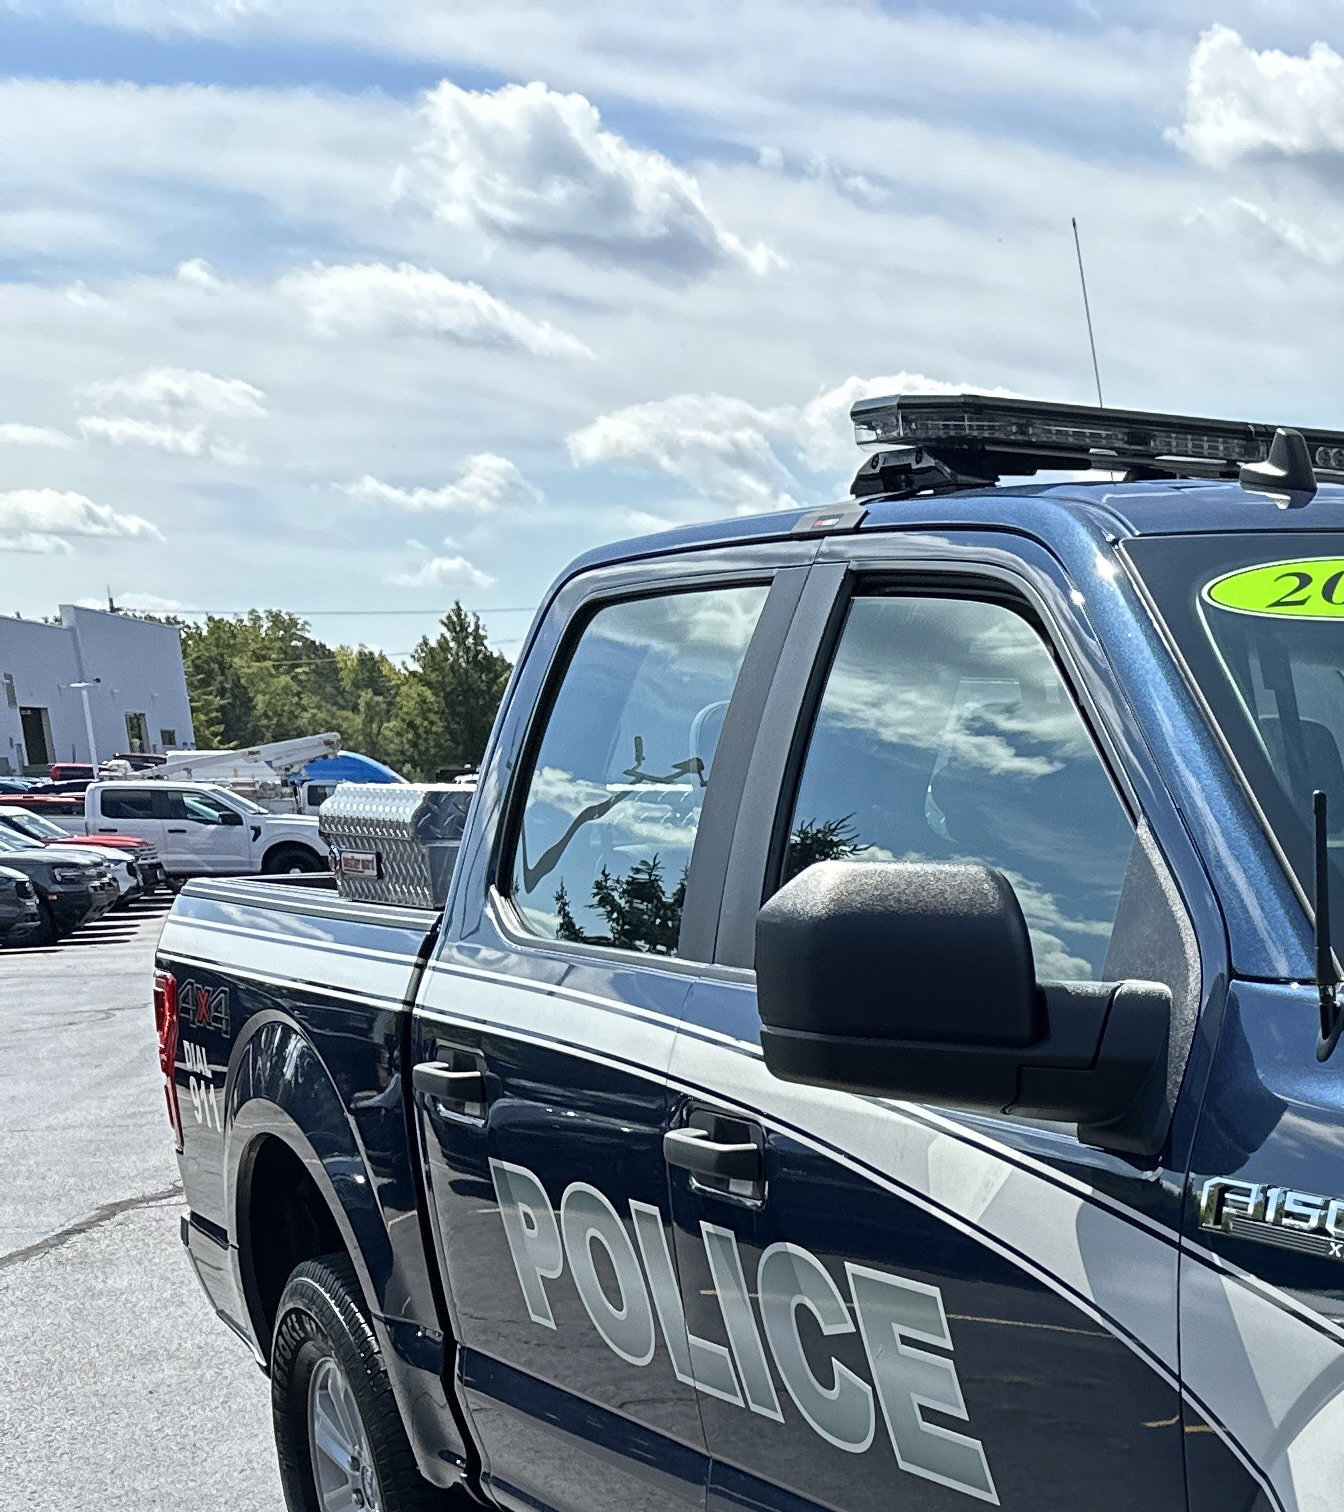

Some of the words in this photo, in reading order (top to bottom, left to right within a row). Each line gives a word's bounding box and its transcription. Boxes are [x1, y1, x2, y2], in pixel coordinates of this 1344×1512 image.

[183, 1040, 212, 1078] DIAL
[189, 1075, 223, 1133] 911
[488, 1157, 1000, 1506] POLICE
